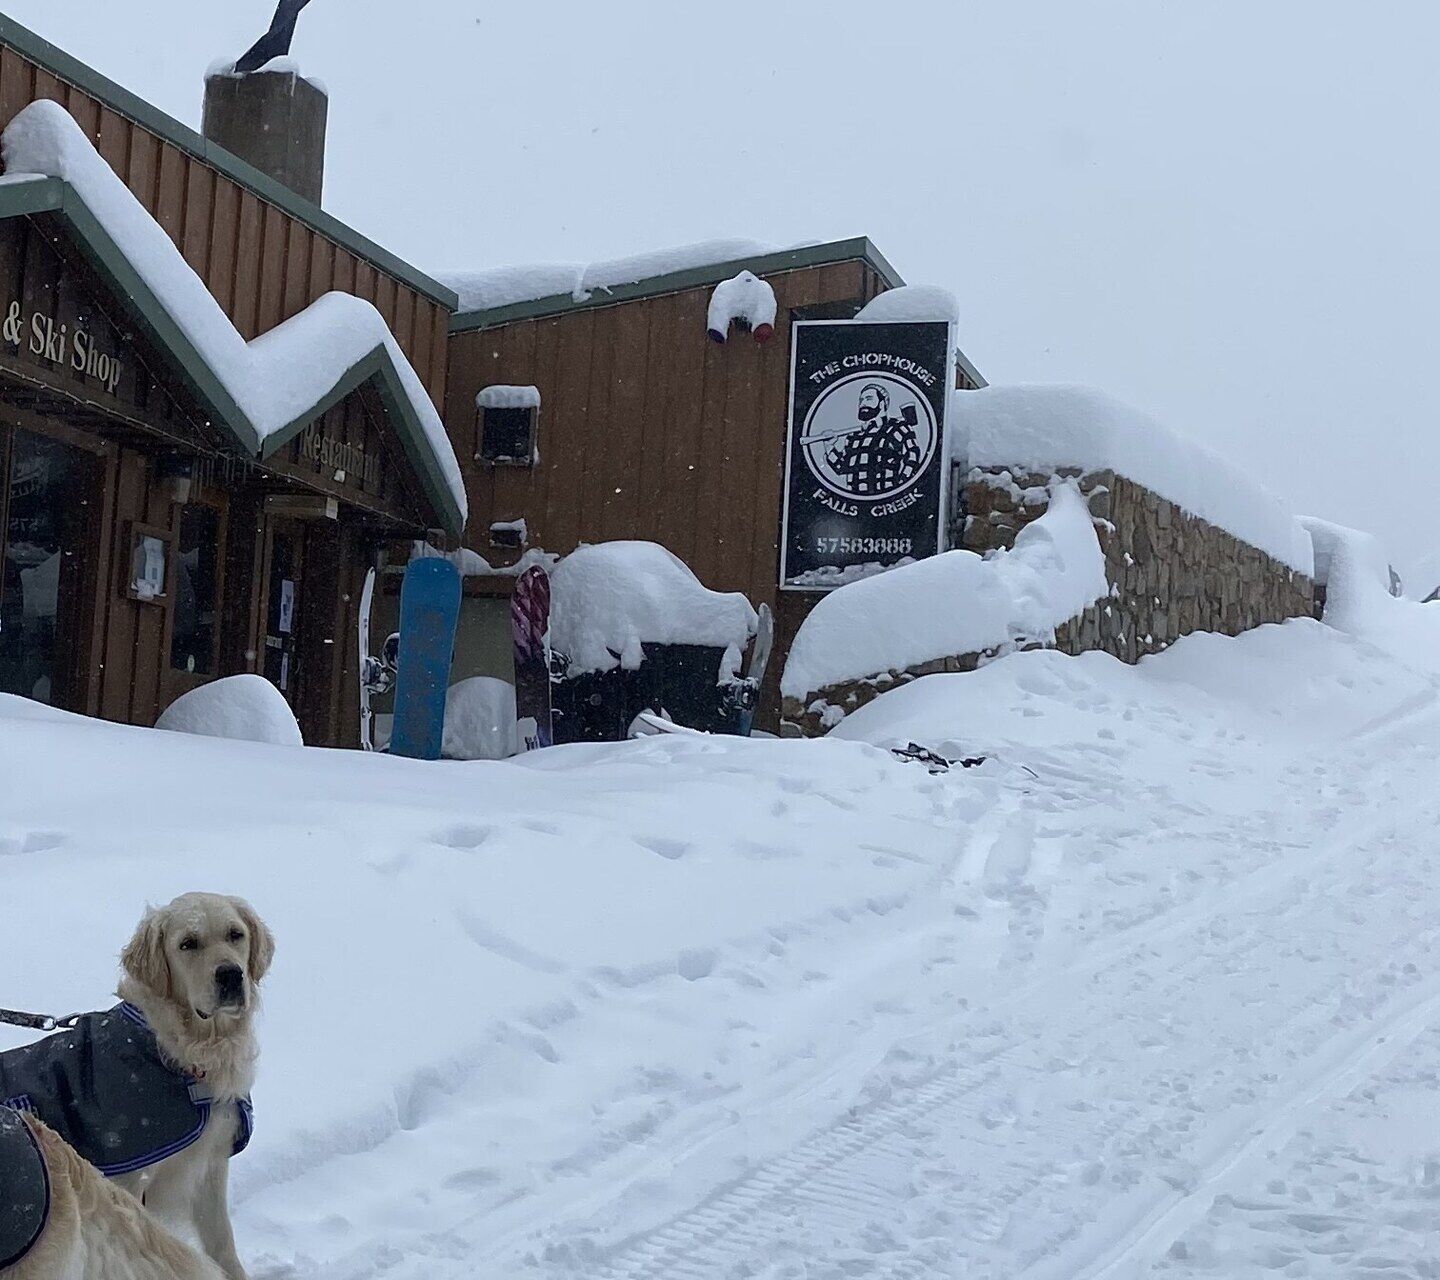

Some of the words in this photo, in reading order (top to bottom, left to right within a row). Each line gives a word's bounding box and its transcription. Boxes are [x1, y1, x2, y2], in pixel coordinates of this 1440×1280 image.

[3, 300, 23, 346] &
[29, 312, 67, 365] Ski
[71, 329, 121, 394] Shop
[809, 361, 841, 384] THE
[842, 352, 937, 387] CHOPHOUSE
[812, 488, 858, 517] FALLS
[870, 487, 924, 517] CREEK
